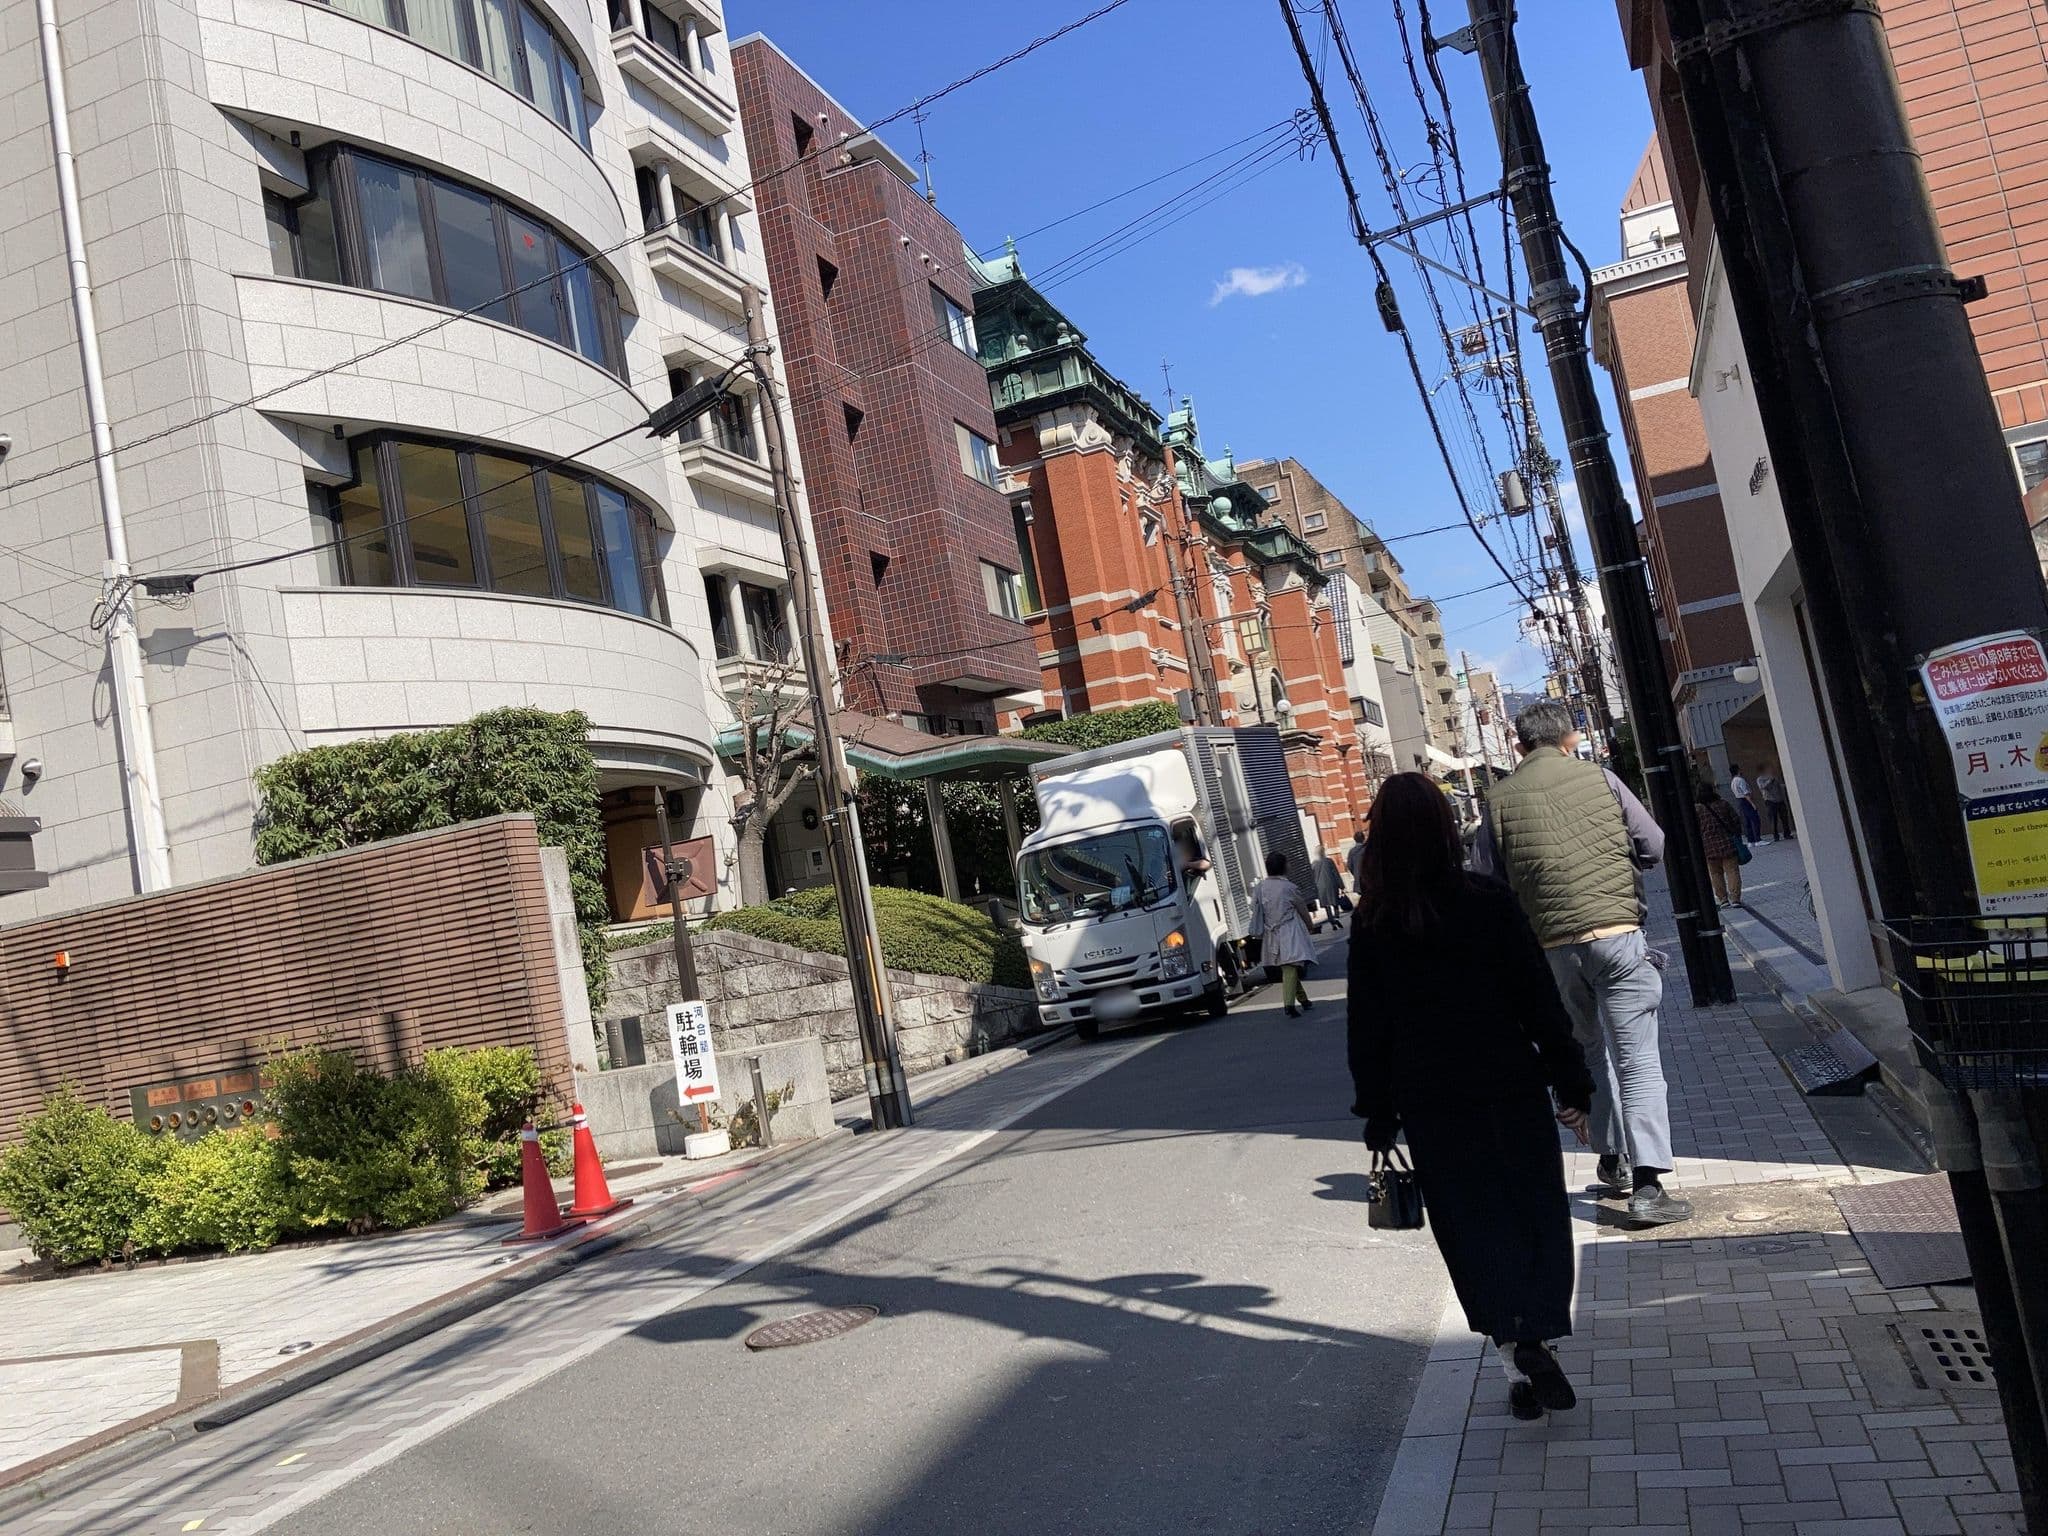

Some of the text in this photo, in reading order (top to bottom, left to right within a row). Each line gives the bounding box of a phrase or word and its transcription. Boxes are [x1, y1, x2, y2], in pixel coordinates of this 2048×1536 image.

[1084, 946, 1122, 960] ISUZU
[675, 1011, 703, 1080] 駐輪場
